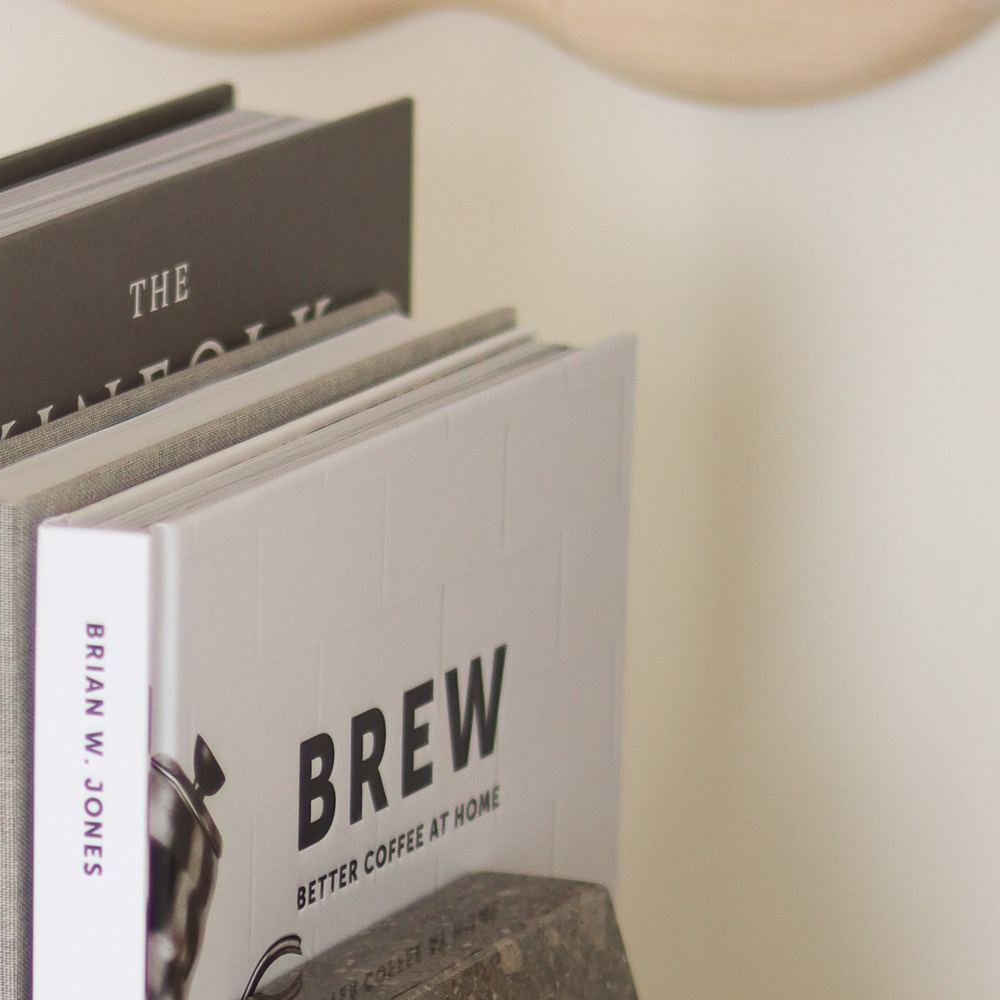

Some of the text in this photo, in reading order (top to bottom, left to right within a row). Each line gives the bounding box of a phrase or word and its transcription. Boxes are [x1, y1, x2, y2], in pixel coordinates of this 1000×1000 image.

[129, 264, 190, 319] THE
[83, 623, 105, 877] BRIAN W. JONES
[298, 643, 507, 852] BREW
[296, 785, 501, 911] BETTER COFFEE AT HOME
